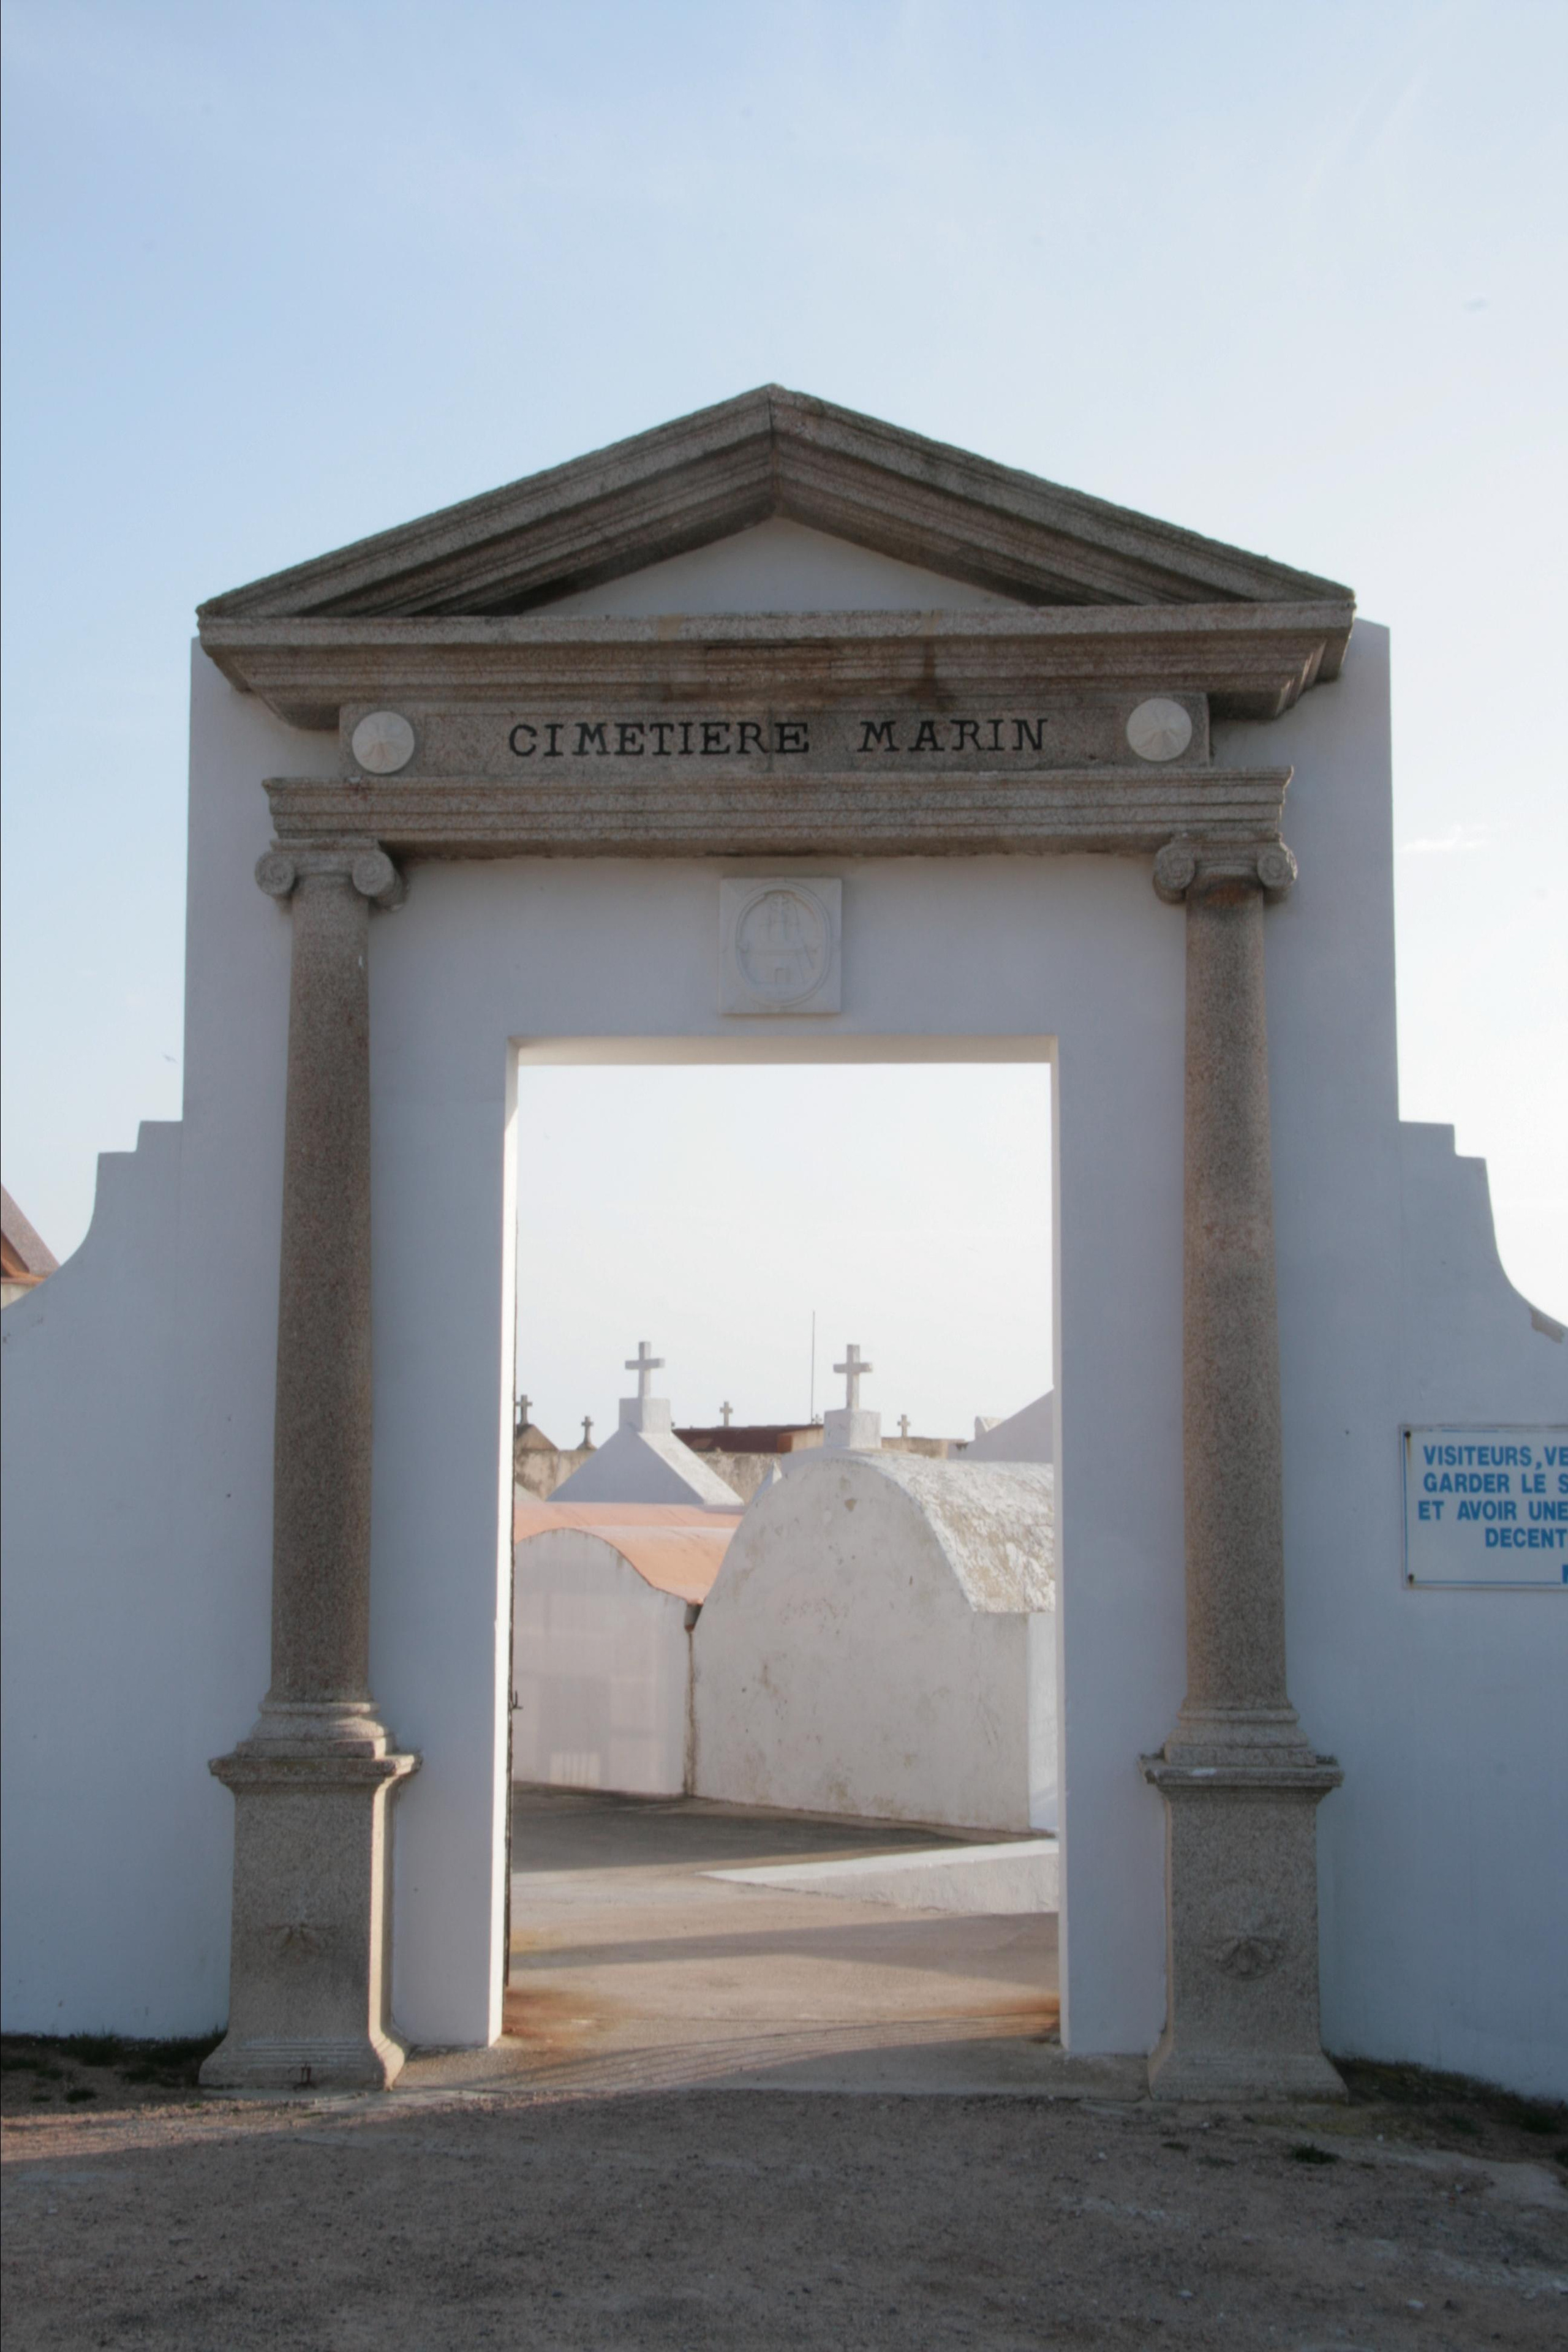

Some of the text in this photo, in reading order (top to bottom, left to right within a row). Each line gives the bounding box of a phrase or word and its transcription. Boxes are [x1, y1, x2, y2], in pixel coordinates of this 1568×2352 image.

[508, 718, 1048, 756] CIMETIERE MARIN
[1423, 1472, 1510, 1493] GARDER
[1521, 1473, 1547, 1493] LE
[1417, 1501, 1568, 1521] ET AVOIR UNE
[1485, 1528, 1567, 1548] DECENT
